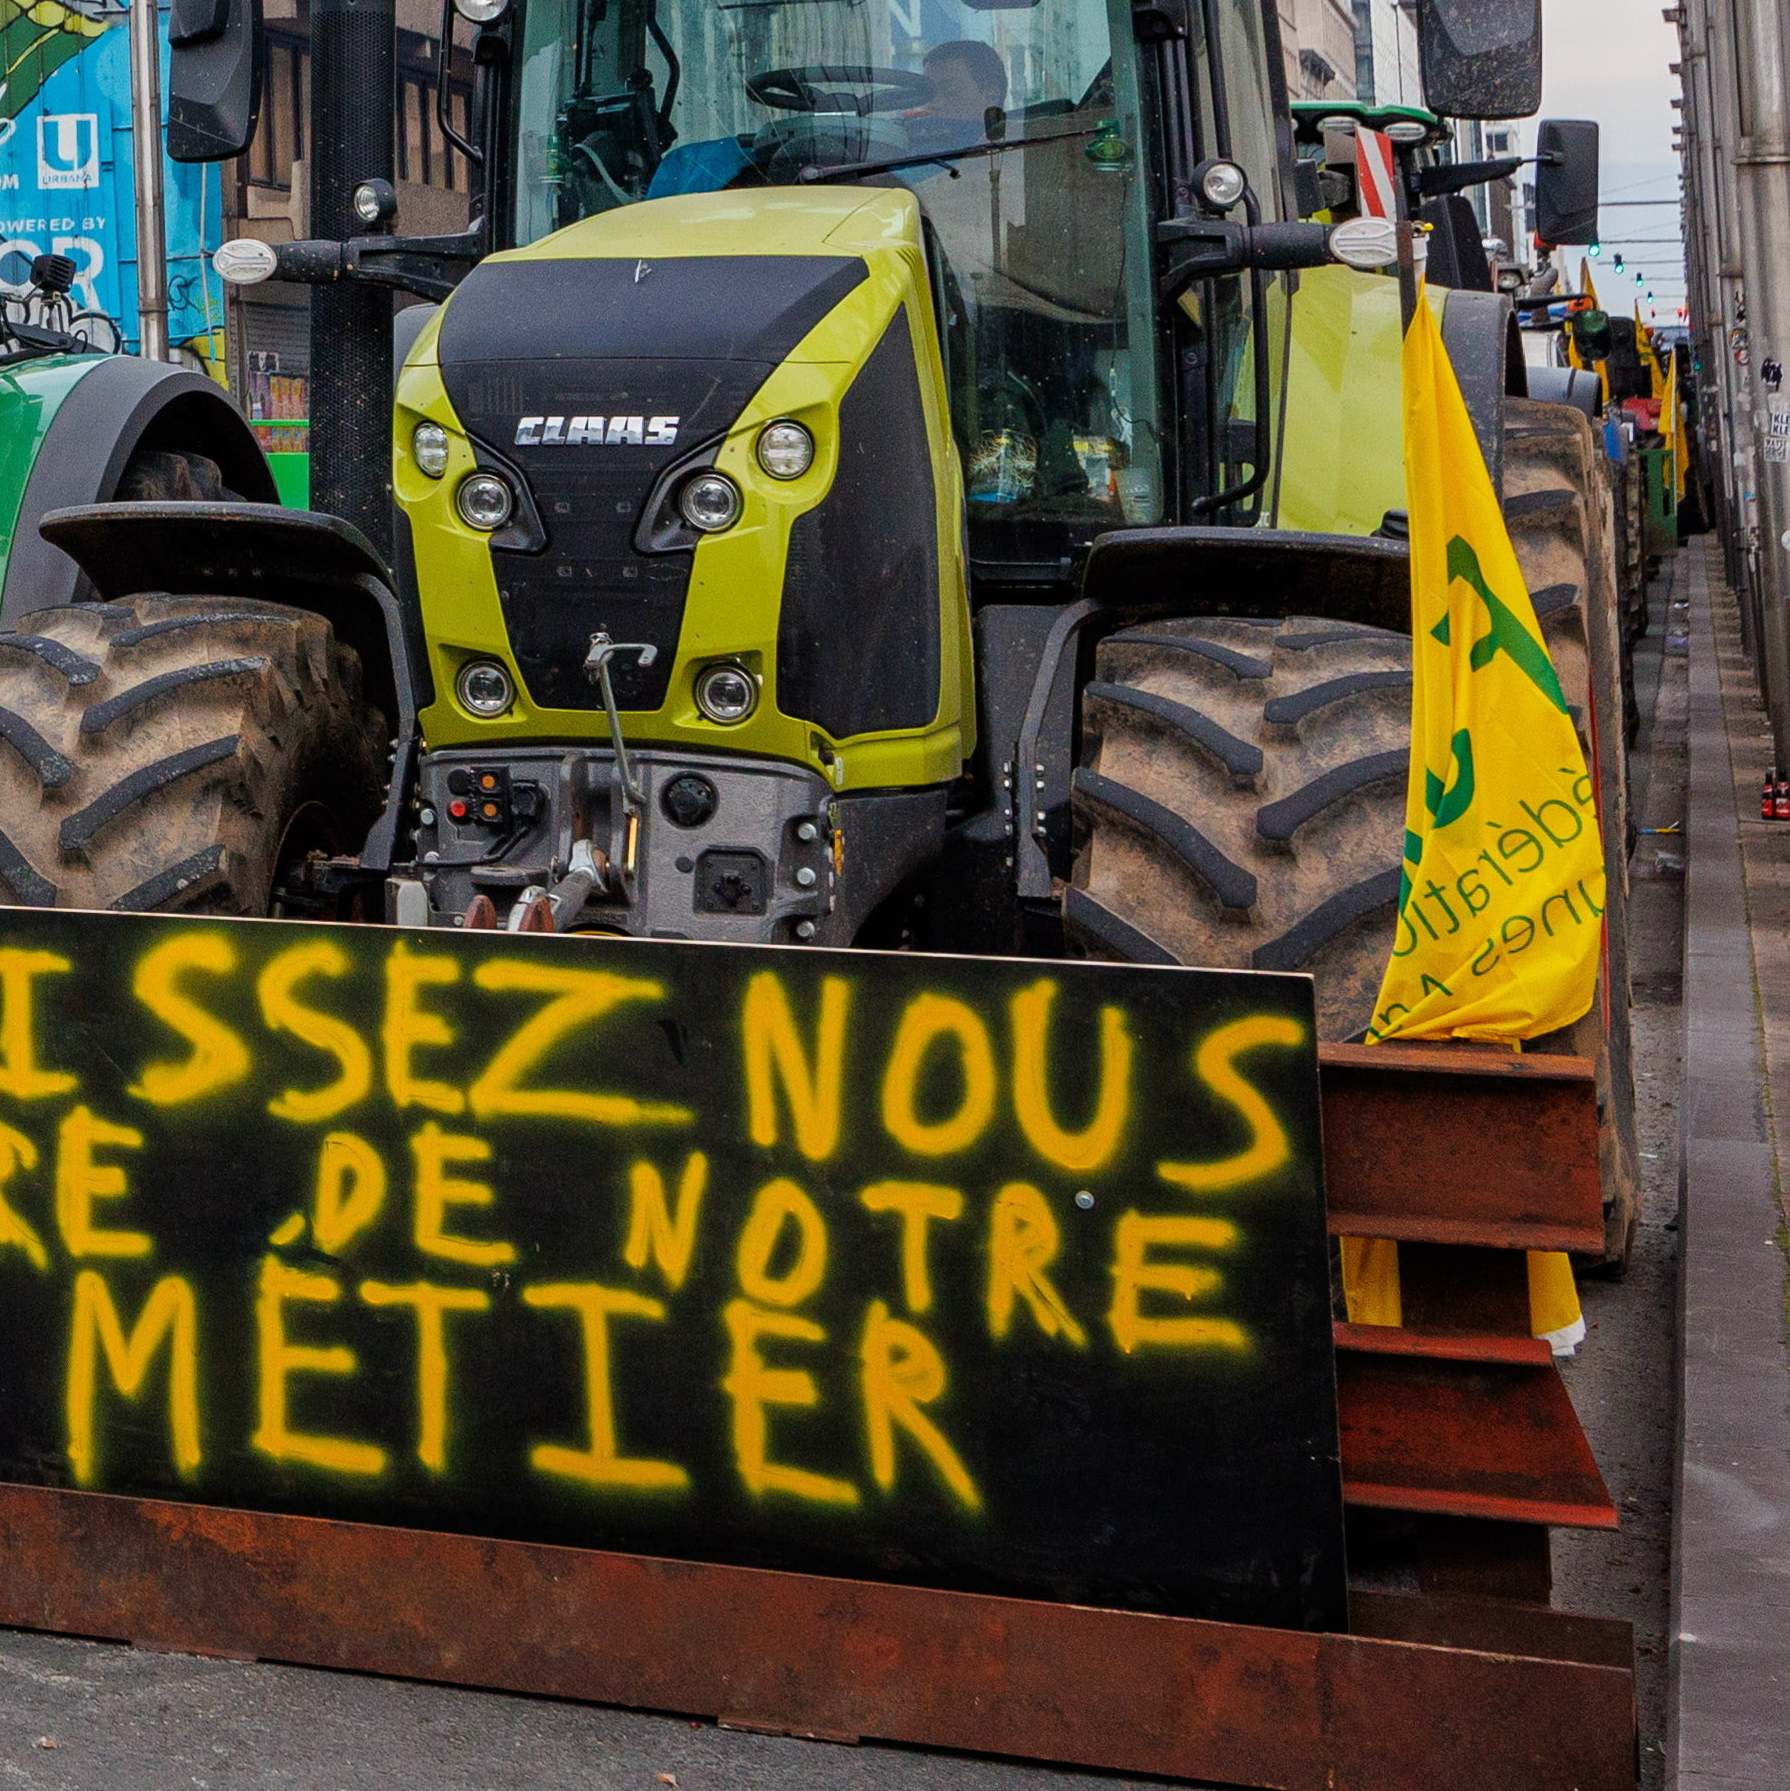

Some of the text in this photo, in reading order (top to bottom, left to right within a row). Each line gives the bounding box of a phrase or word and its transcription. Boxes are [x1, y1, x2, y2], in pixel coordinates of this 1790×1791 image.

[82, 215, 107, 232] BY
[514, 416, 680, 446] CLAAS
[740, 969, 1308, 1193] NOUS
[314, 1121, 518, 1266] DE
[623, 1149, 1253, 1353] NOTRE
